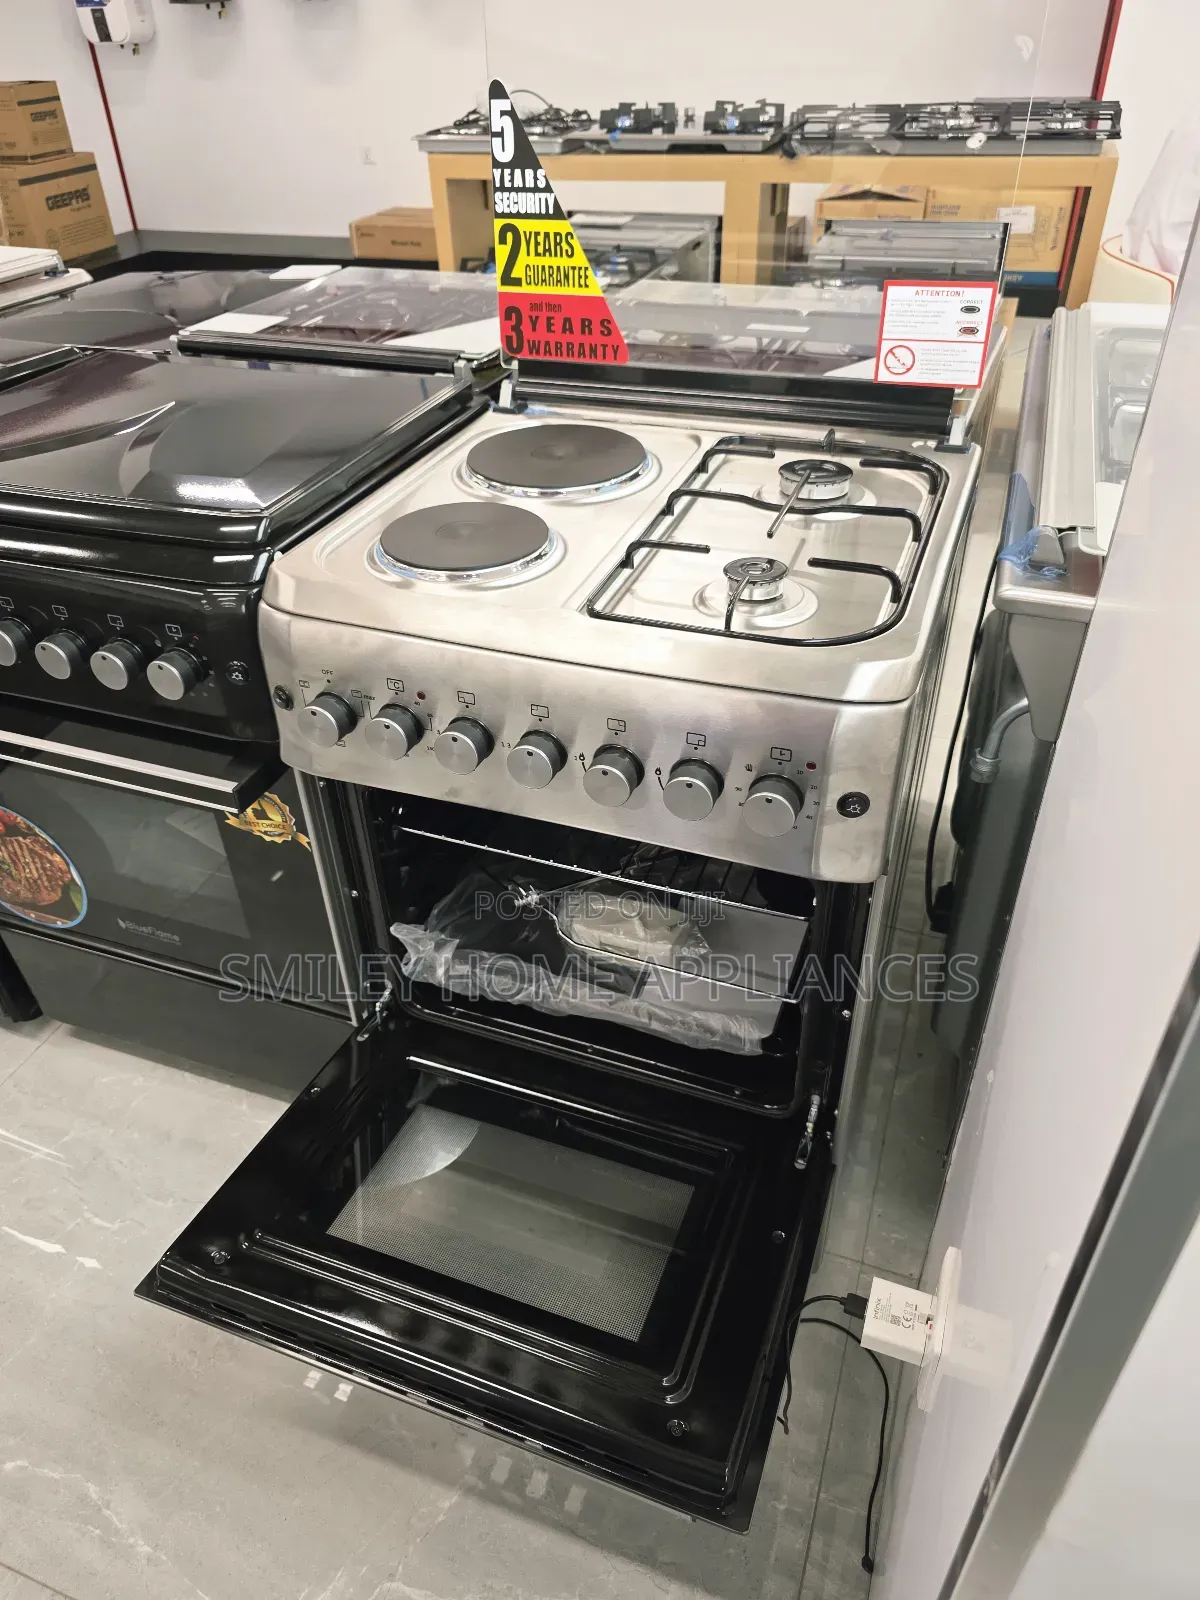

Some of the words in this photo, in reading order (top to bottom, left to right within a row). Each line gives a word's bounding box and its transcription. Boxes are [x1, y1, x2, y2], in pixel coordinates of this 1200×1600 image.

[490, 99, 515, 163] 5
[493, 168, 546, 189] YEARS
[45, 186, 91, 211] GEEPAS
[494, 191, 556, 215] SECURITY
[498, 223, 522, 287] 2
[523, 230, 575, 259] YEARS
[524, 264, 590, 289] GUARANTEE
[914, 289, 965, 298] ATTENTION!
[529, 302, 543, 313] and
[545, 302, 562, 313] then
[503, 306, 525, 355] 3
[528, 315, 613, 337] YEARS
[526, 339, 620, 361] WARRANTY
[321, 668, 334, 676] OFF
[261, 822, 287, 831] CHOICE
[125, 920, 180, 942] BlueFlame
